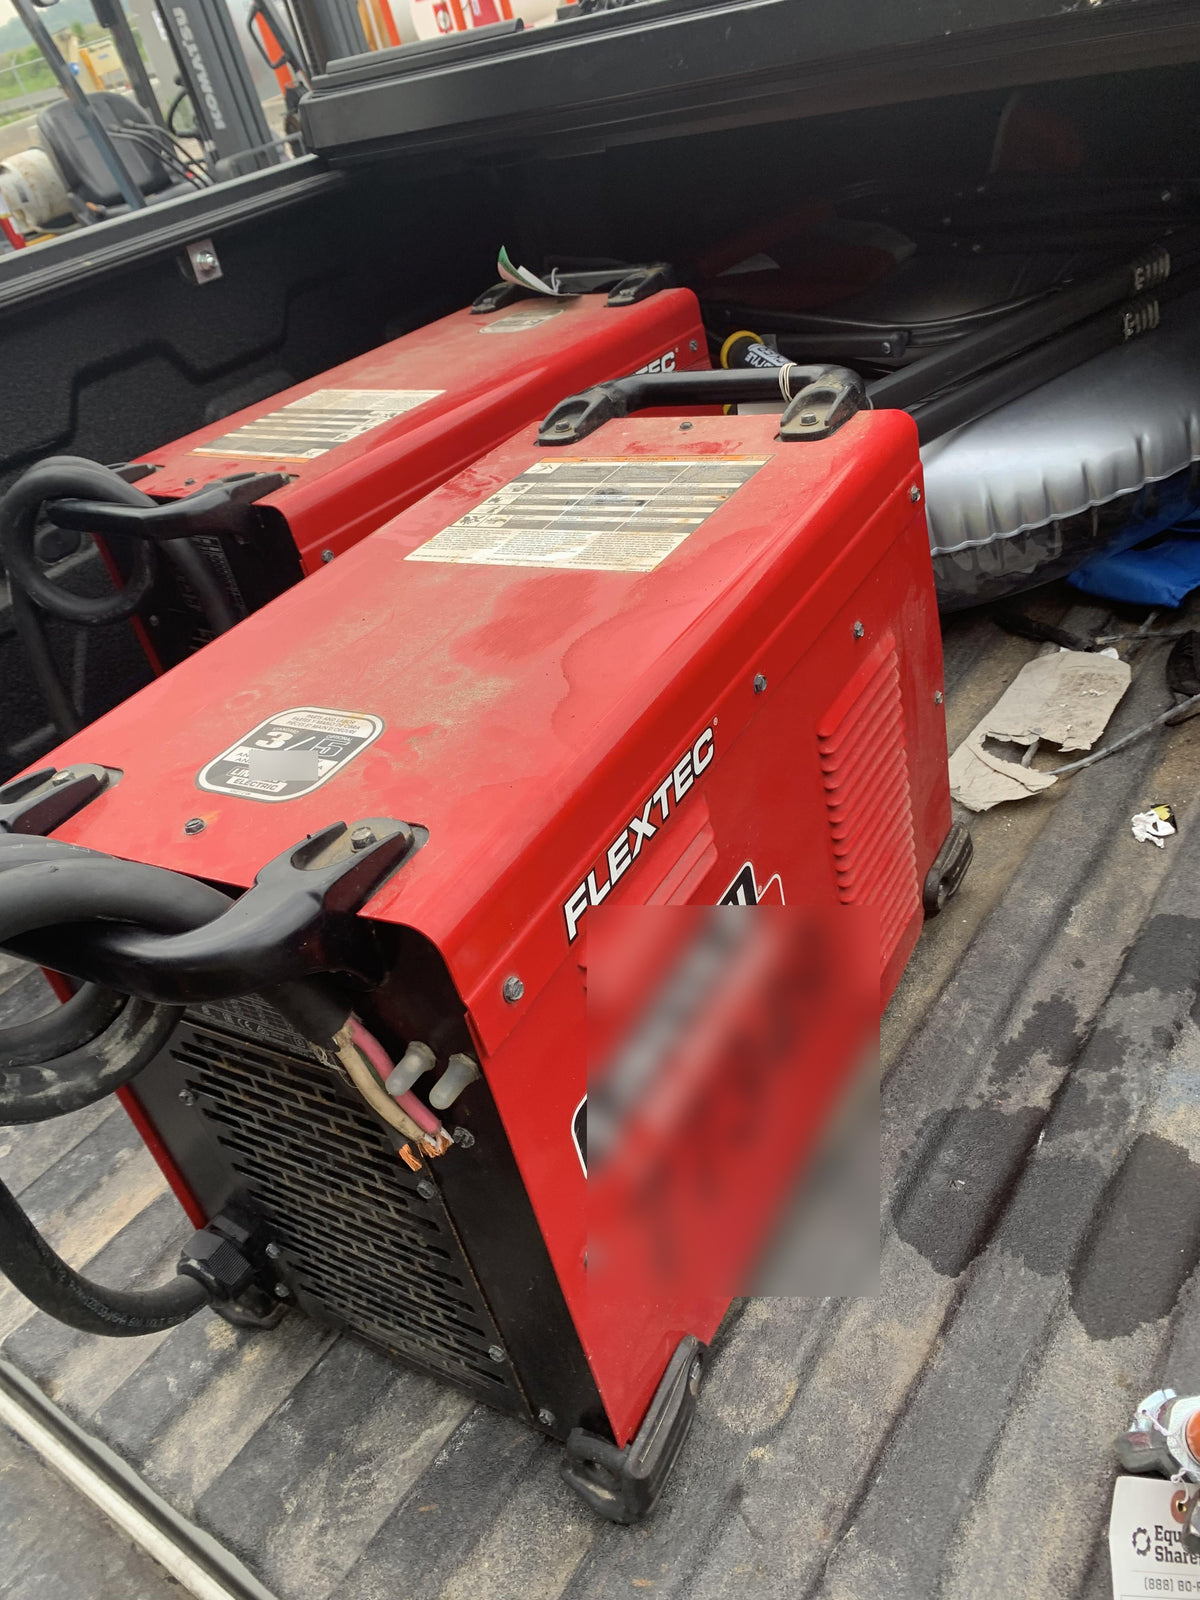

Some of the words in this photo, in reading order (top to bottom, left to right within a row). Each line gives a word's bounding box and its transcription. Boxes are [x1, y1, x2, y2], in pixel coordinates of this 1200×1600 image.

[172, 7, 226, 130] KOMATSU
[232, 778, 279, 791] ELECTRIC
[562, 726, 715, 945] FLEXTEC
[1144, 1577, 1173, 1592] (888)
